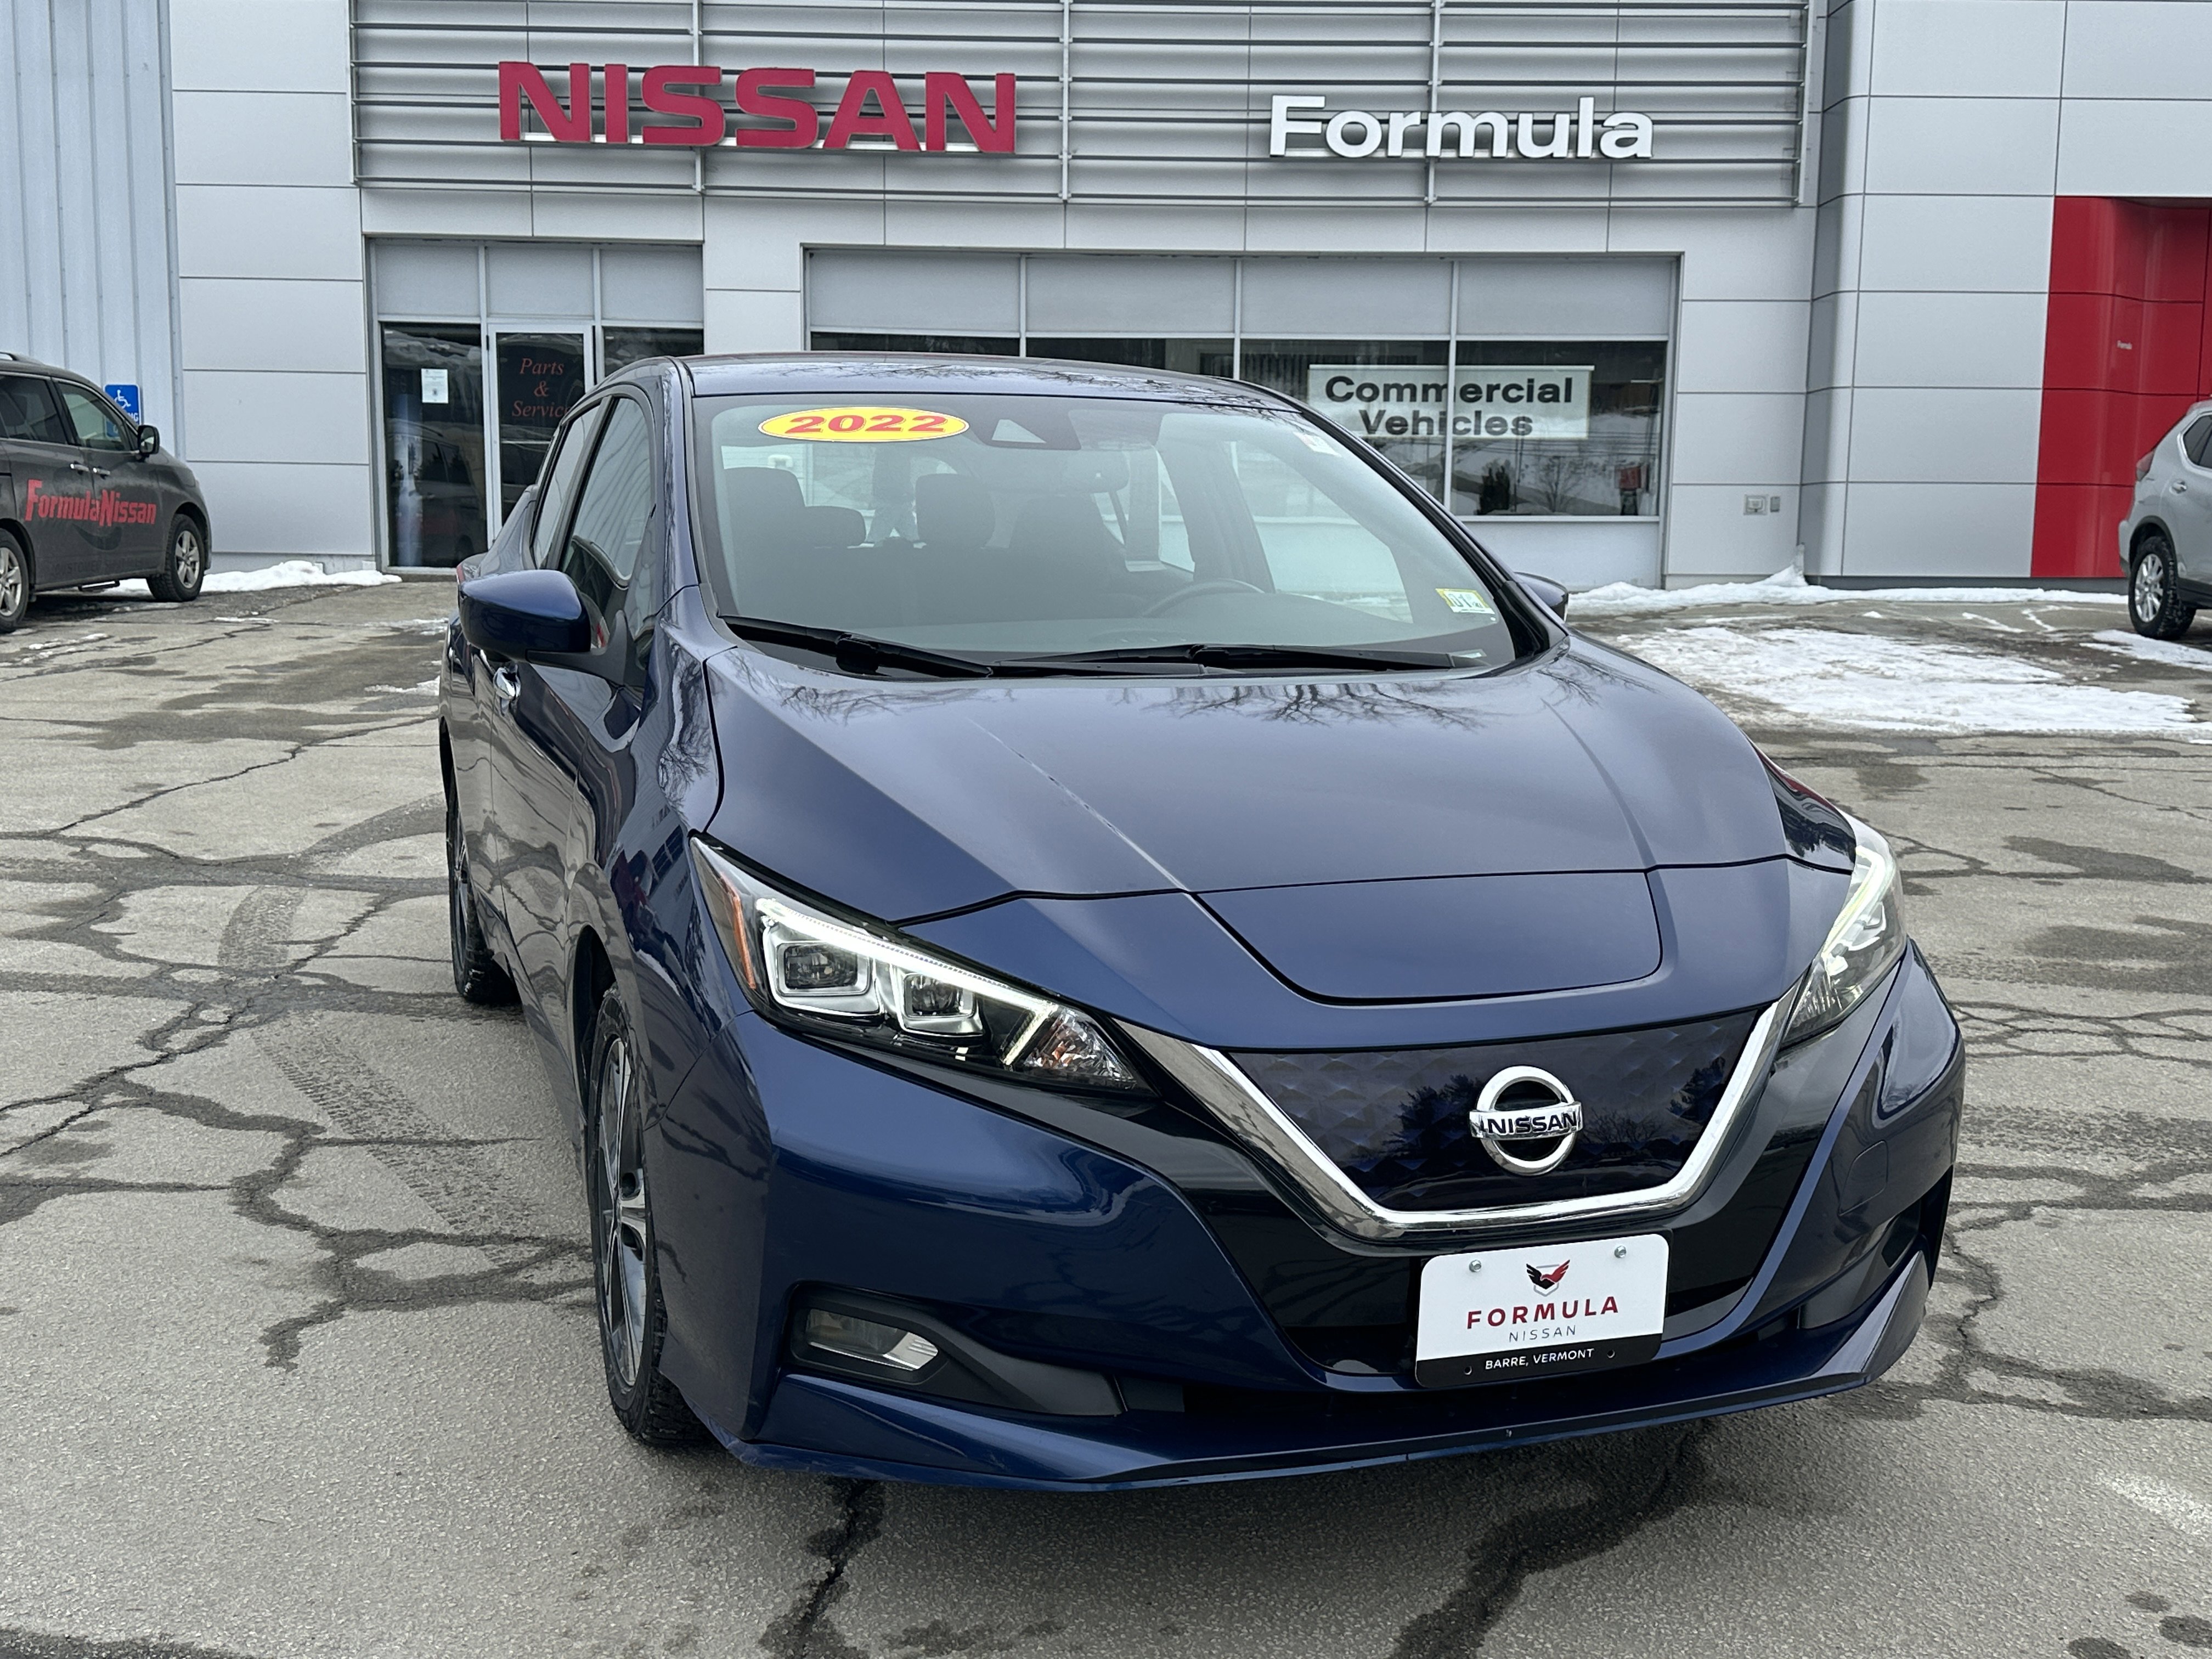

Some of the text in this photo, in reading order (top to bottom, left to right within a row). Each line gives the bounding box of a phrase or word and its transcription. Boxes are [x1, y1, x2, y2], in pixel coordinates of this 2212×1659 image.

[499, 61, 1016, 154] NISSAN
[1269, 94, 1654, 158] Formula
[520, 358, 565, 375] Parts
[534, 381, 549, 397] &
[1325, 376, 1573, 403] Commercial
[785, 415, 948, 434] 2022
[1359, 410, 1533, 436] Vehicles
[1487, 1111, 1577, 1134] NISSAN
[1467, 1296, 1618, 1330] FORMULA
[1509, 1325, 1576, 1342] NISSAN
[1485, 1348, 1595, 1370] BARRE, VERMONT
